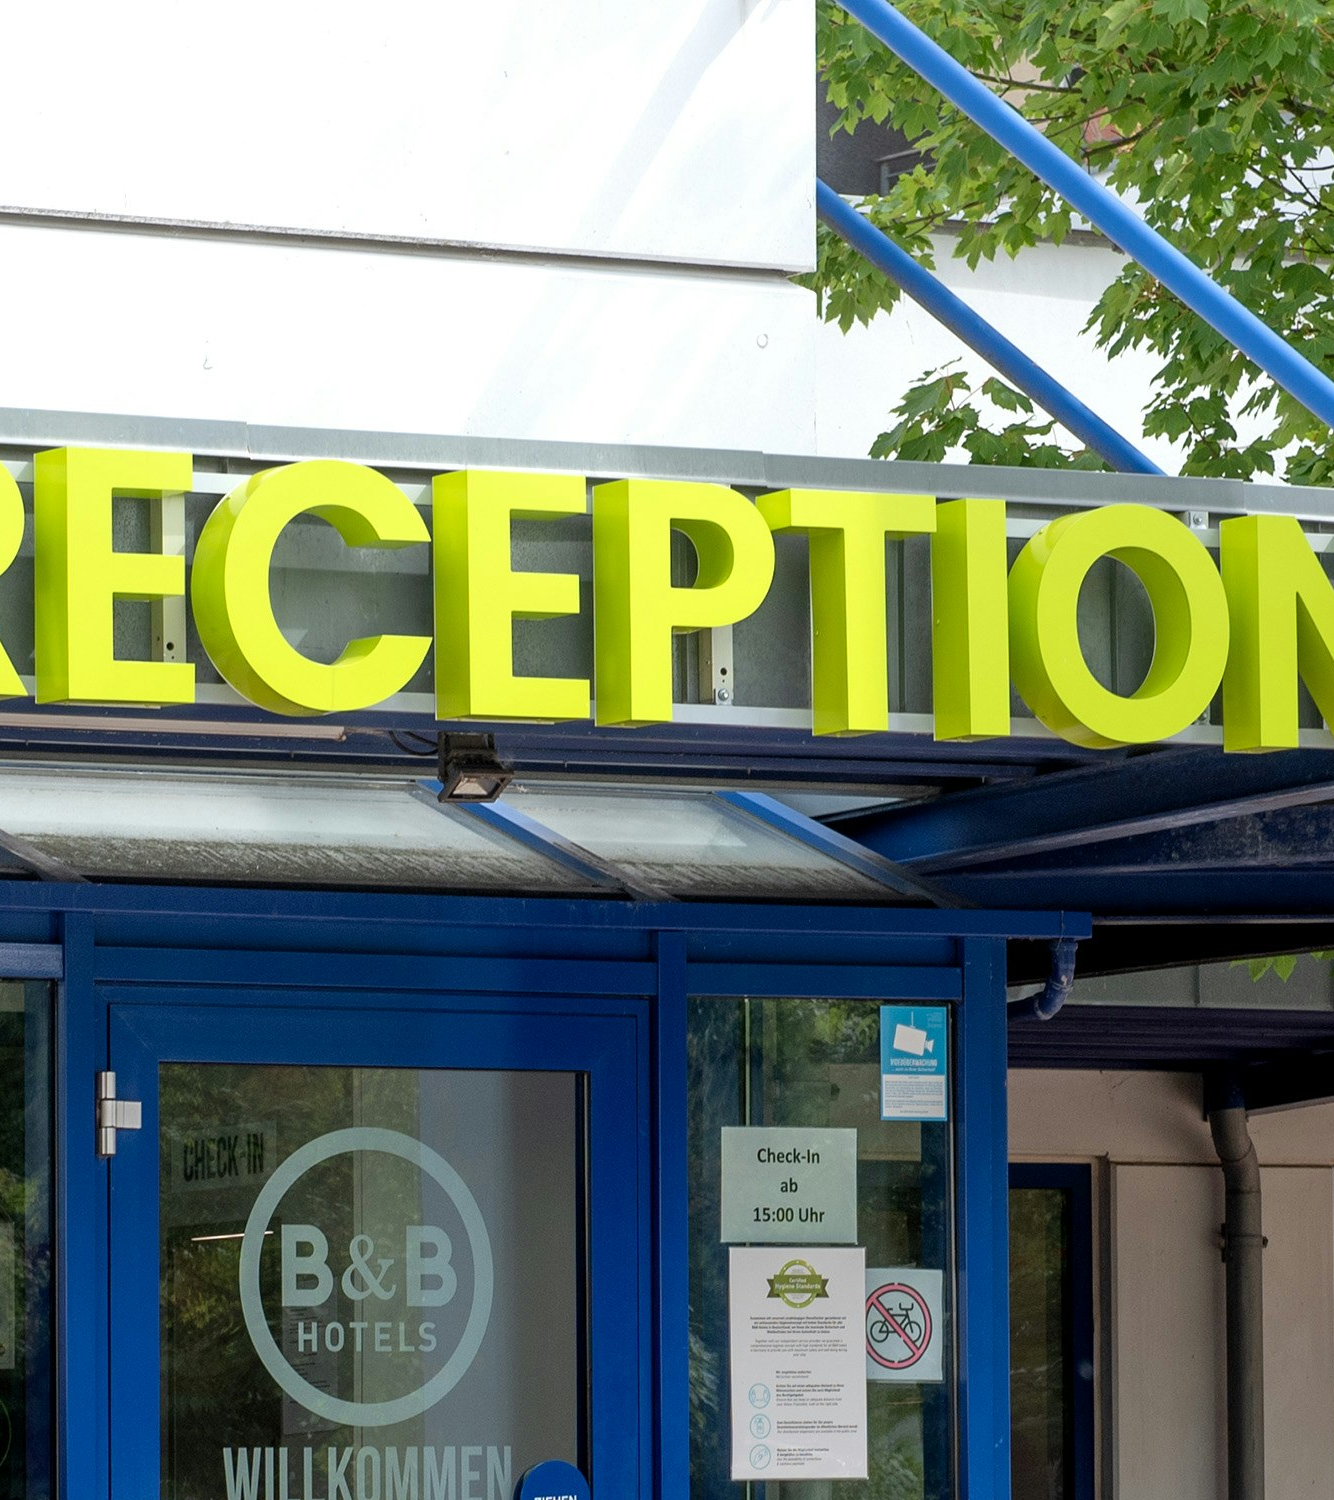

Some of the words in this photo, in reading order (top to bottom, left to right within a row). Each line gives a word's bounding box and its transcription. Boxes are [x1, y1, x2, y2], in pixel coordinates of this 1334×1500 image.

[183, 1132, 264, 1182] CHECK-IN
[756, 1147, 821, 1166] Check-In
[780, 1178, 799, 1194] ab
[753, 1207, 795, 1223] 15:00
[799, 1207, 825, 1225] Uhr
[281, 1223, 458, 1308] B&B
[298, 1321, 438, 1353] HOTELS
